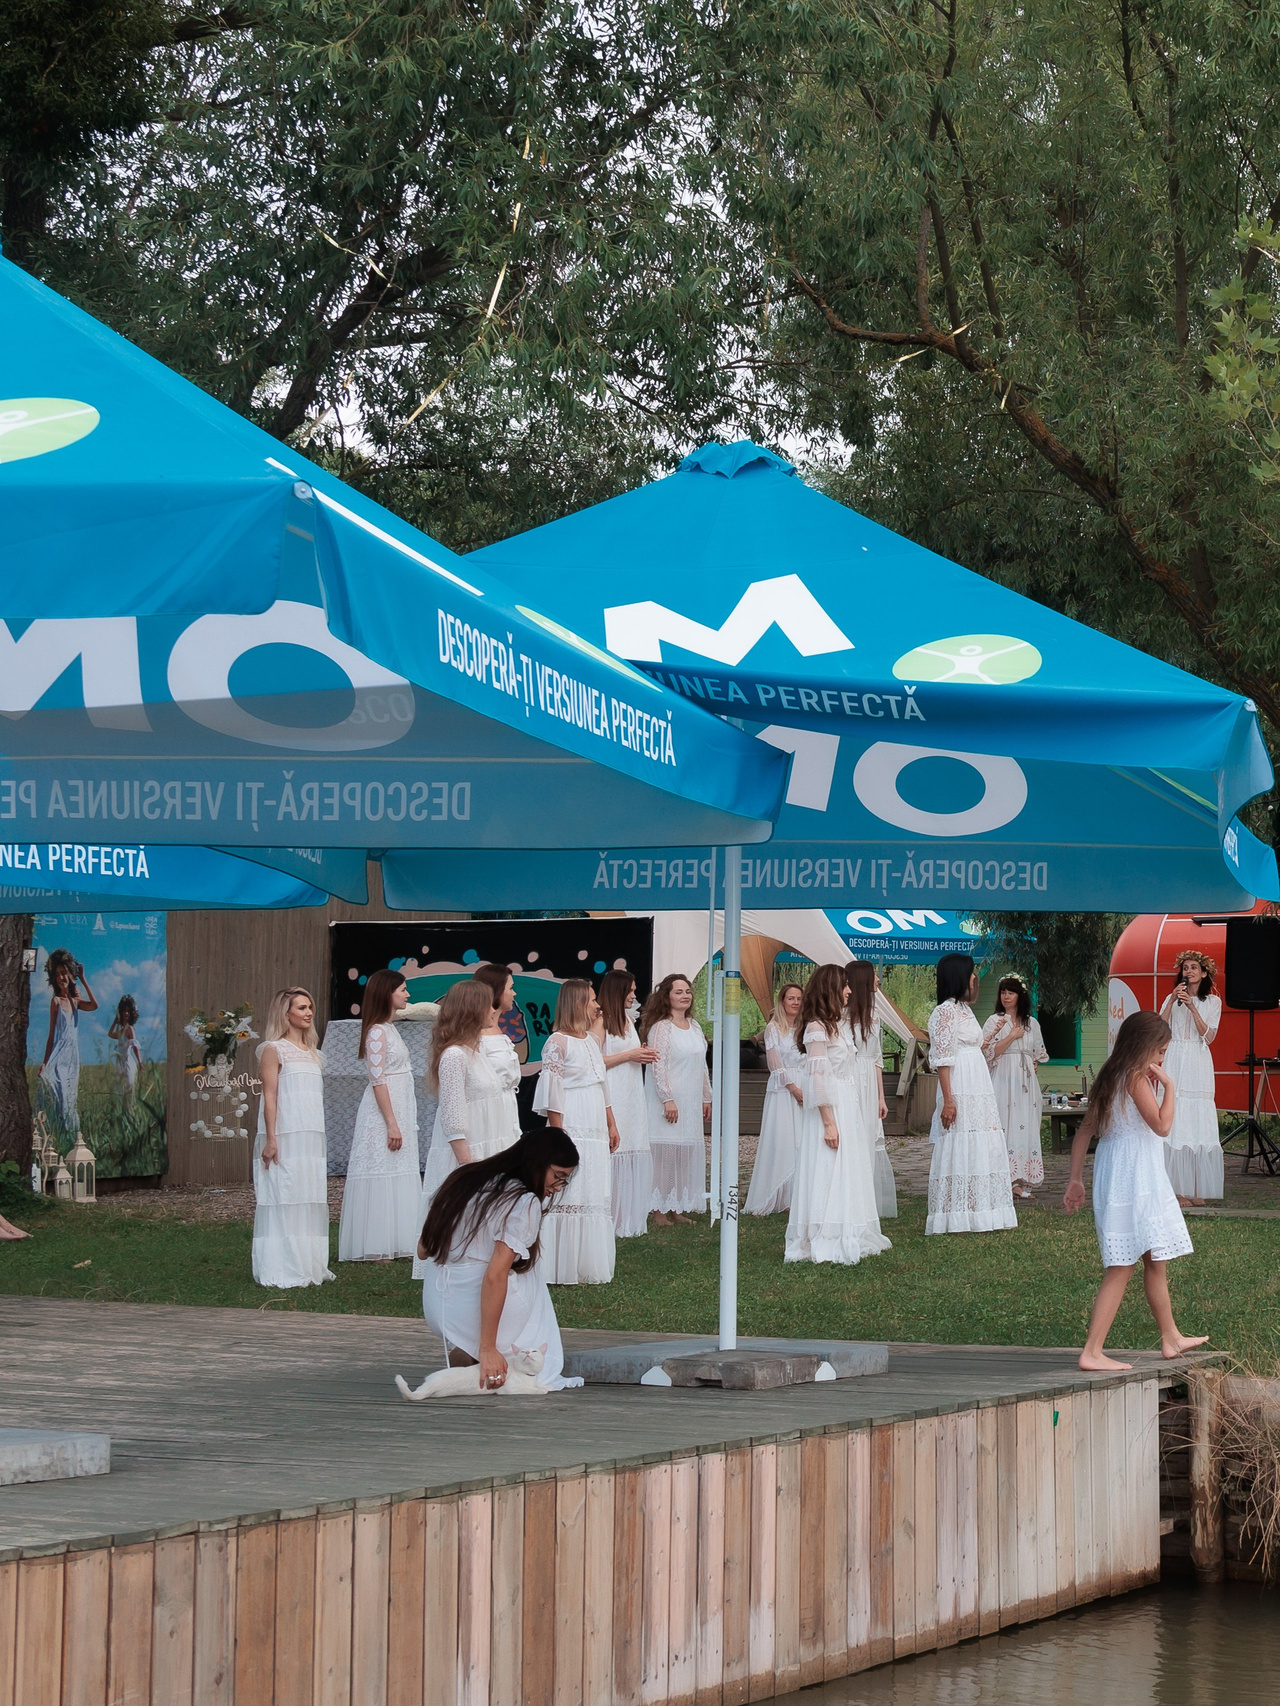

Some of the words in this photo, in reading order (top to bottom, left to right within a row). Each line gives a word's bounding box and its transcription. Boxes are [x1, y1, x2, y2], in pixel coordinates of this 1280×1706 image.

[535, 661, 610, 739] VERSIUNEA
[611, 709, 676, 766] PERFECTĂ
[755, 685, 927, 721] PERFECTĂ
[48, 844, 149, 879] PERFECTĂ
[846, 909, 947, 934] OM
[900, 940, 939, 951] VERSIUNEA
[526, 1002, 551, 1019] PA
